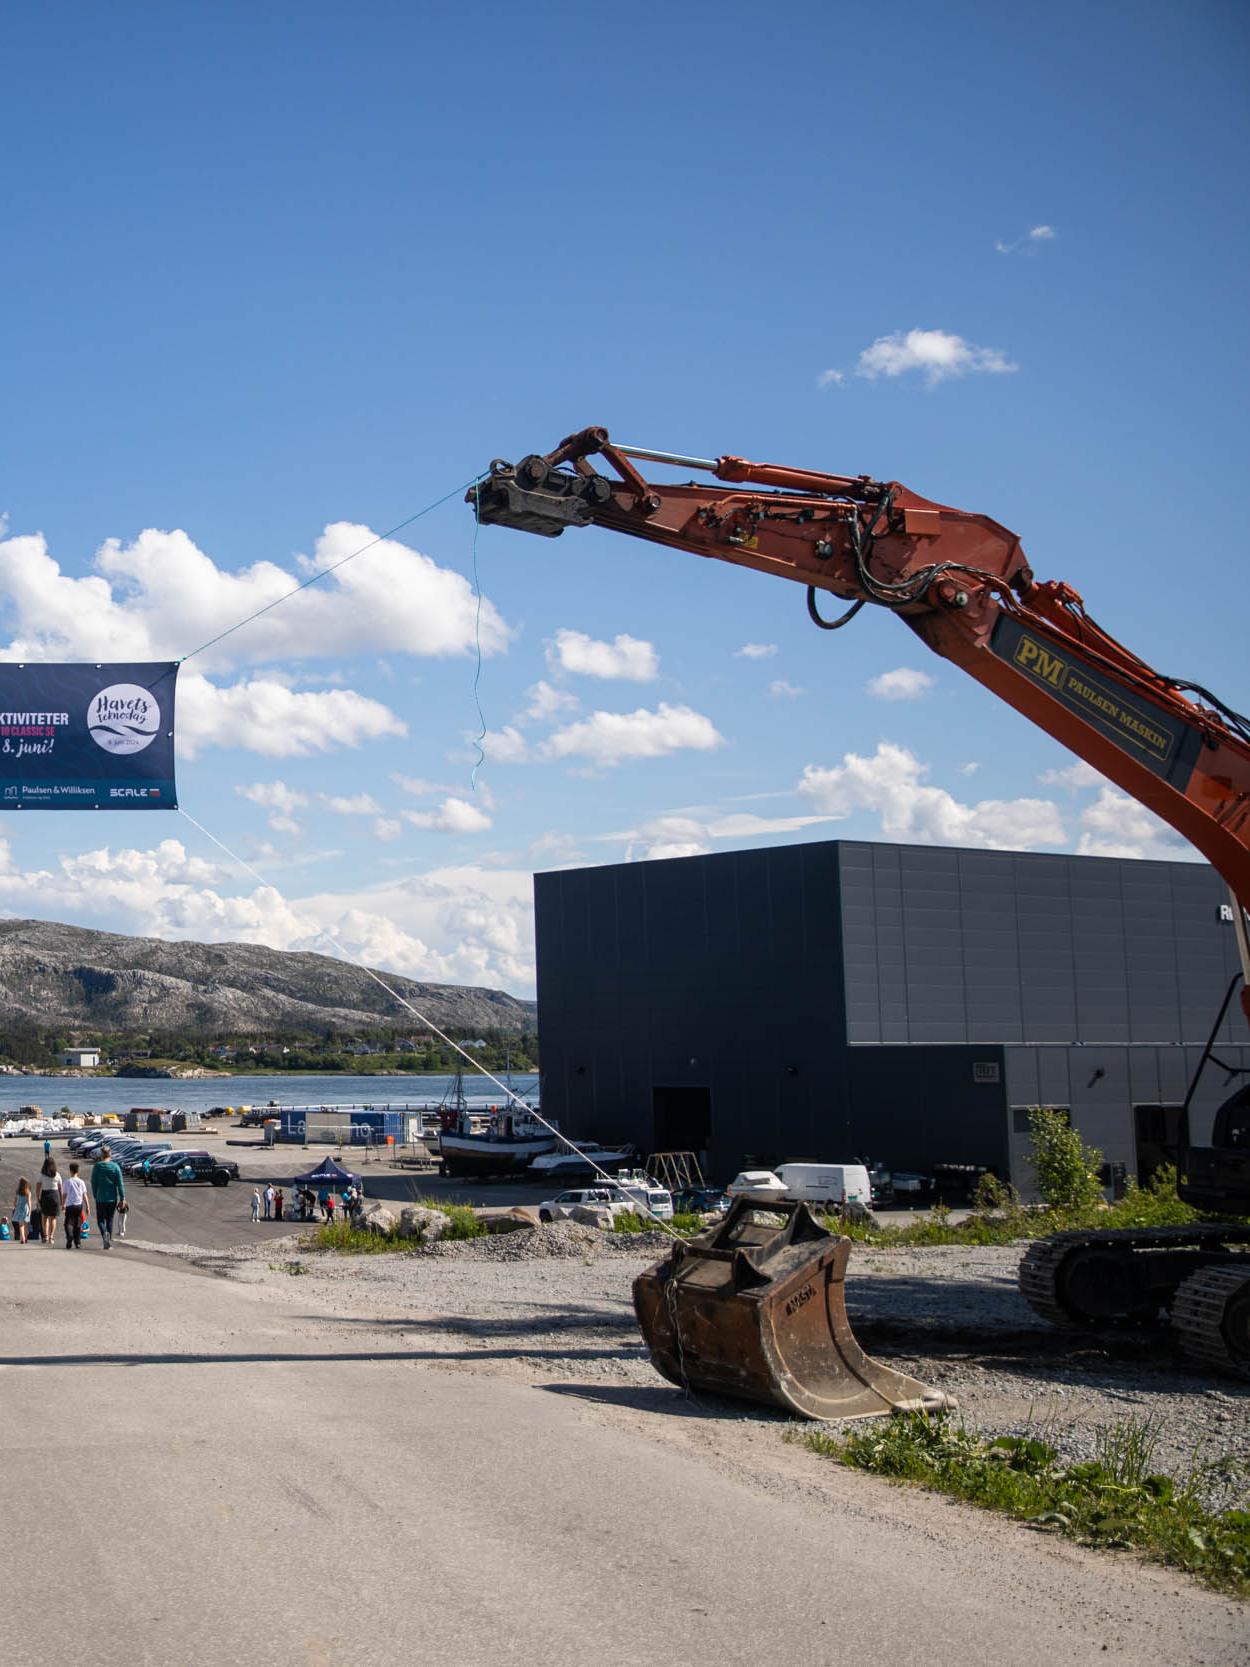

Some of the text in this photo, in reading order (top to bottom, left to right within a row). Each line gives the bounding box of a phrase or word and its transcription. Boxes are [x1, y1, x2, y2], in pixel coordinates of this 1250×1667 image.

[1015, 638, 1067, 686] PM
[96, 695, 148, 714] Havets
[1067, 677, 1167, 750] PAULSEN MASKIN
[1, 726, 10, 736] 10
[11, 726, 44, 737] CLASSIC
[45, 727, 55, 737] SE
[2, 738, 15, 753] 8.
[15, 738, 55, 758] juni!
[22, 785, 95, 795] Paulsen & Williksen
[109, 788, 148, 797] SCALE
